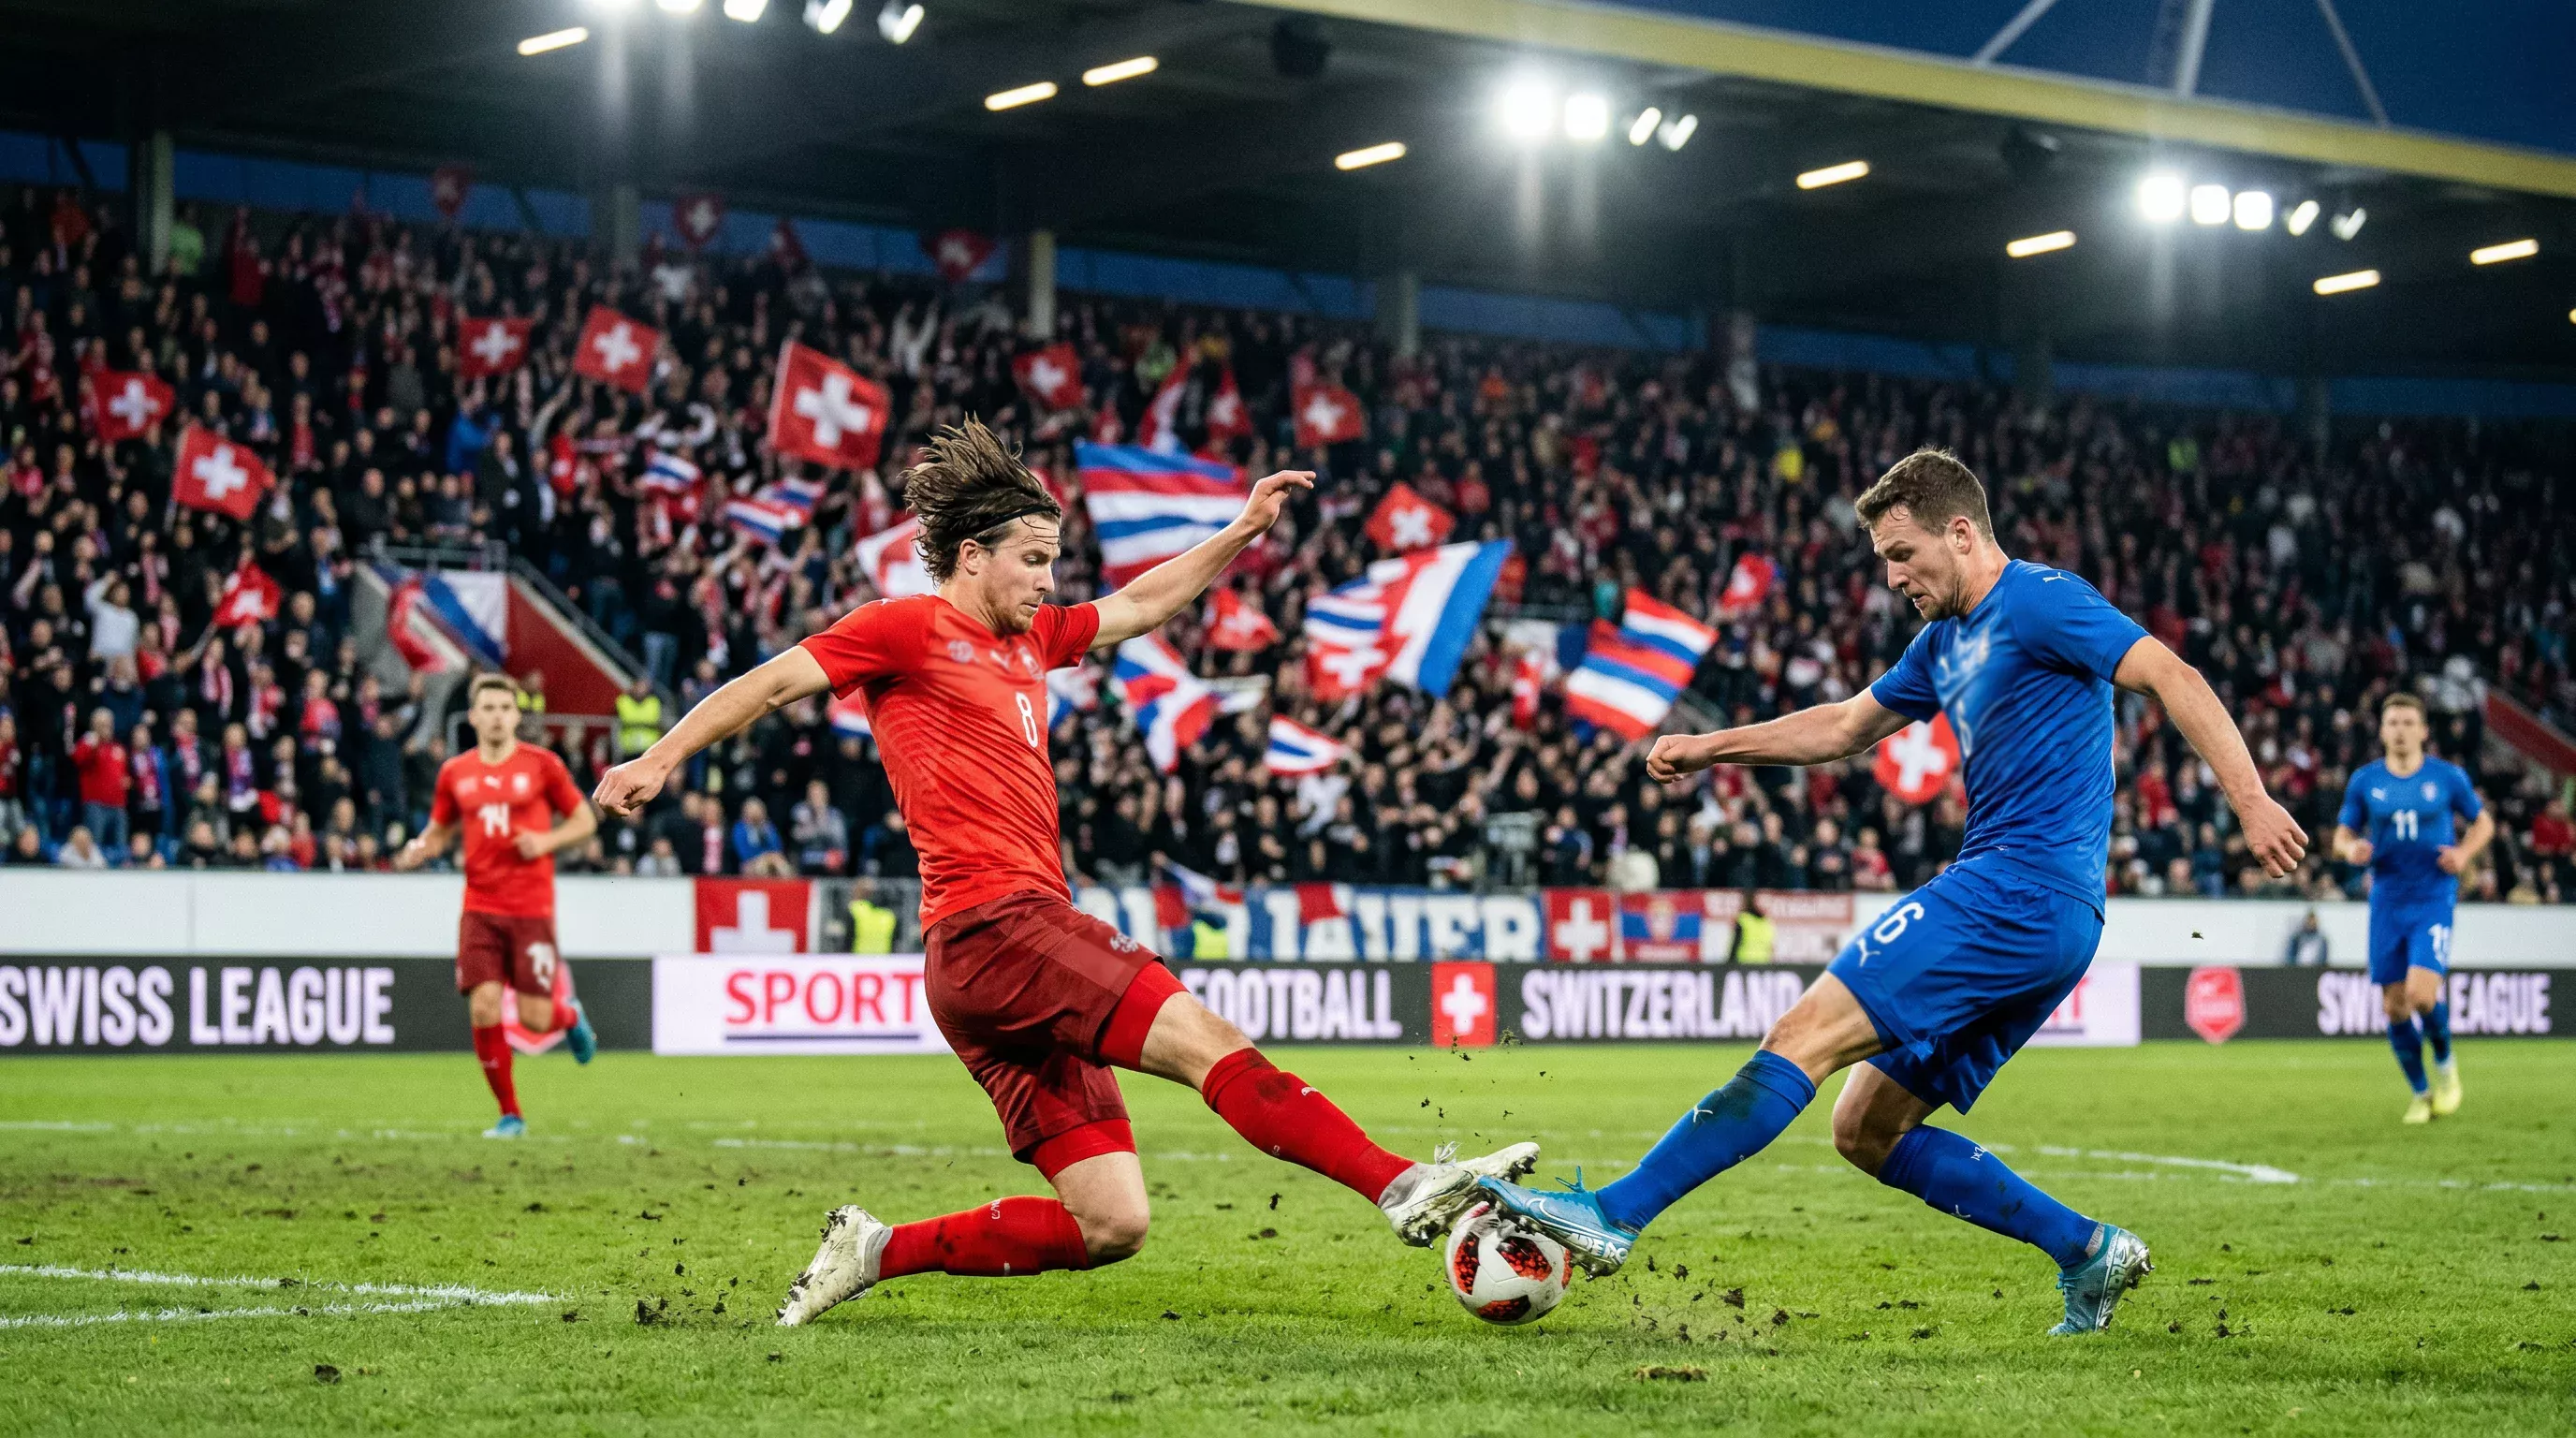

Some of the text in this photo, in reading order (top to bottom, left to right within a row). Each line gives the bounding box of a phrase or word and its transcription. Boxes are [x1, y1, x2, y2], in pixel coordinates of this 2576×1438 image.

[1016, 692, 1038, 748] 8
[478, 802, 510, 838] 14
[2391, 809, 2419, 841] 11
[1874, 902, 1925, 944] 6
[0, 965, 395, 1046] SWISS LEAGUE
[724, 971, 924, 1024] SPORT
[1521, 969, 1803, 1038] SWITZERLAND
[2437, 972, 2552, 1034] EAGUE
